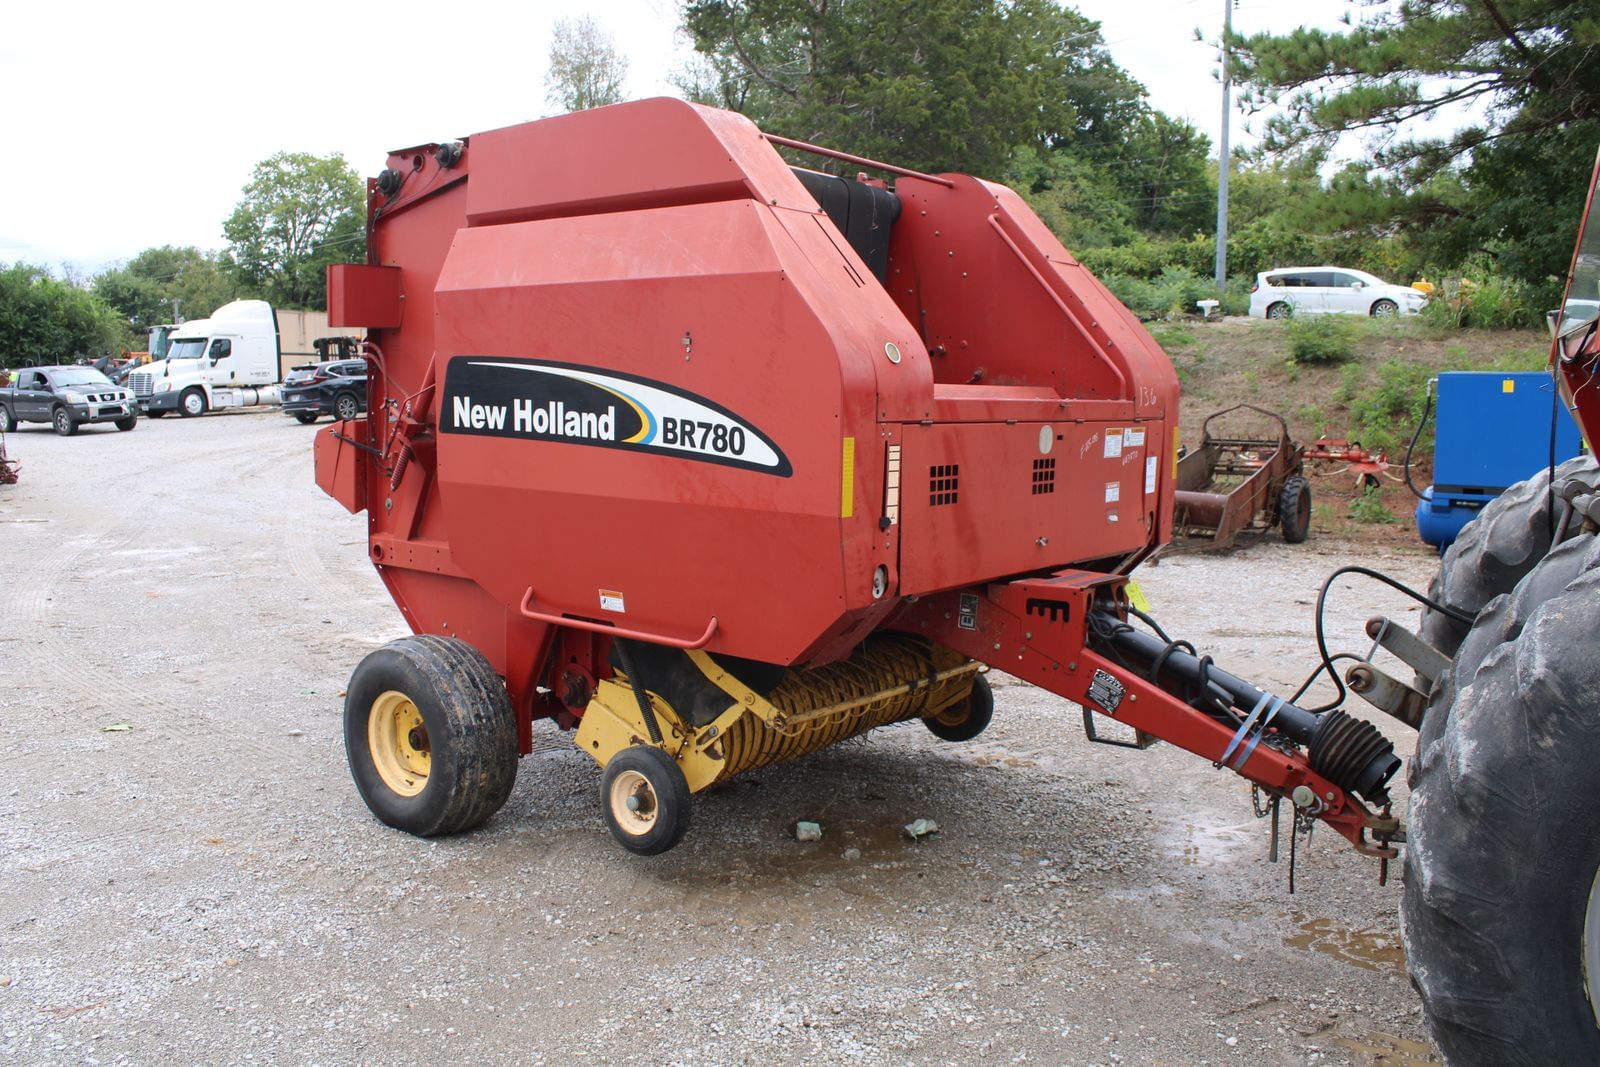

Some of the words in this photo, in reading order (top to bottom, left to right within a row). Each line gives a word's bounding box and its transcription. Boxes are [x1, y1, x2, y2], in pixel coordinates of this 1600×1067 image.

[453, 396, 507, 430] New
[513, 398, 615, 441] Holland
[662, 416, 745, 456] BR780
